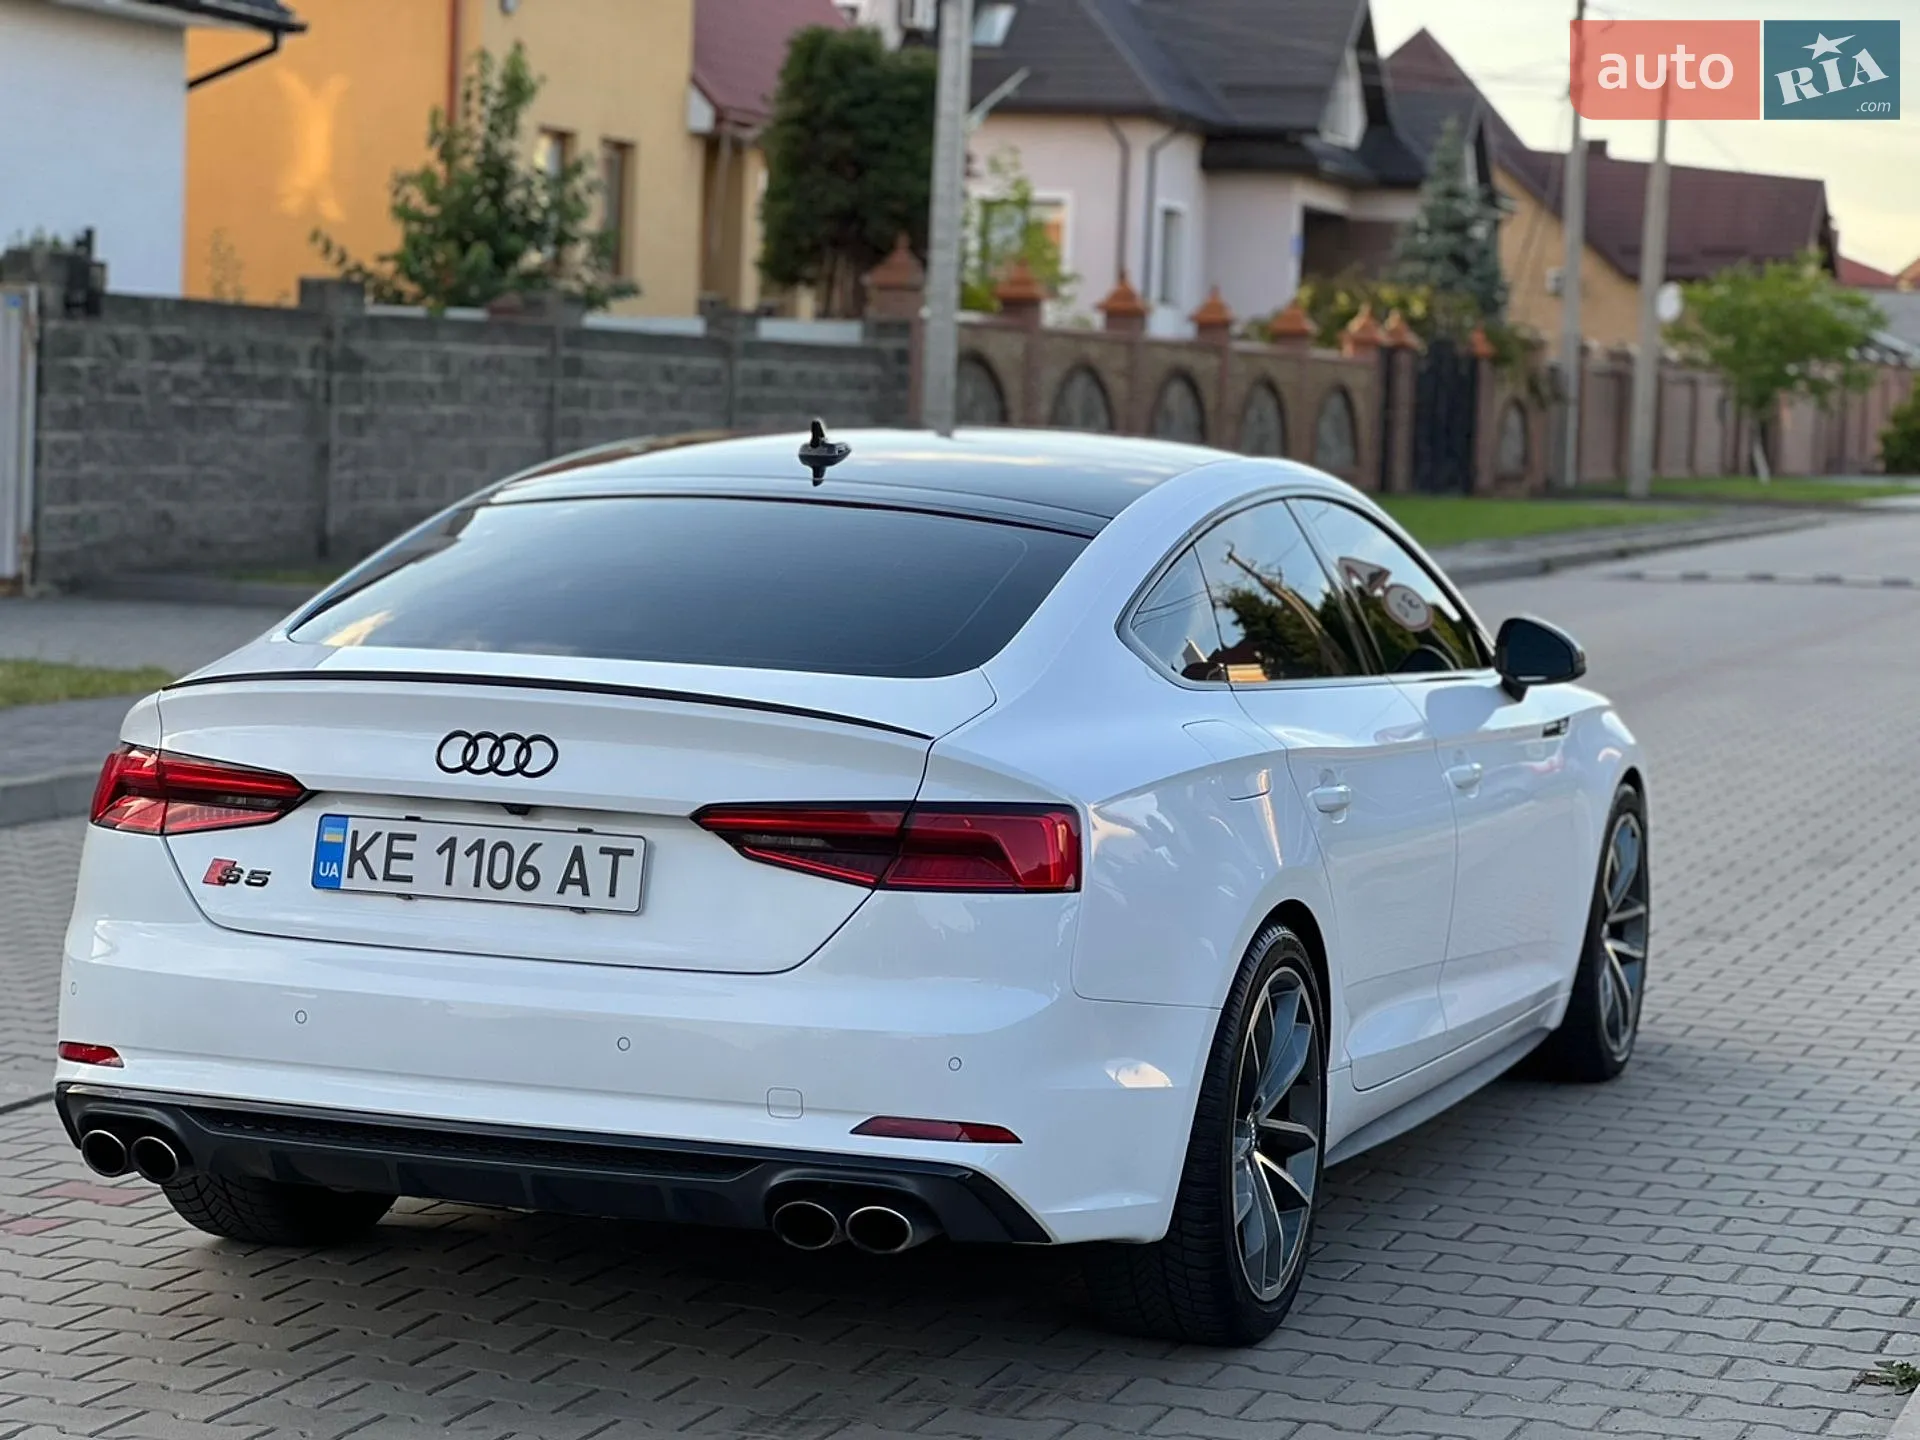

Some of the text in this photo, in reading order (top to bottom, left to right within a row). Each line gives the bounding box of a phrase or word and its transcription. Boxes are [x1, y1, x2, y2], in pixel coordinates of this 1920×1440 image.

[319, 861, 339, 879] UA
[347, 830, 634, 897] KE 1106 AT
[217, 866, 271, 887] S5
